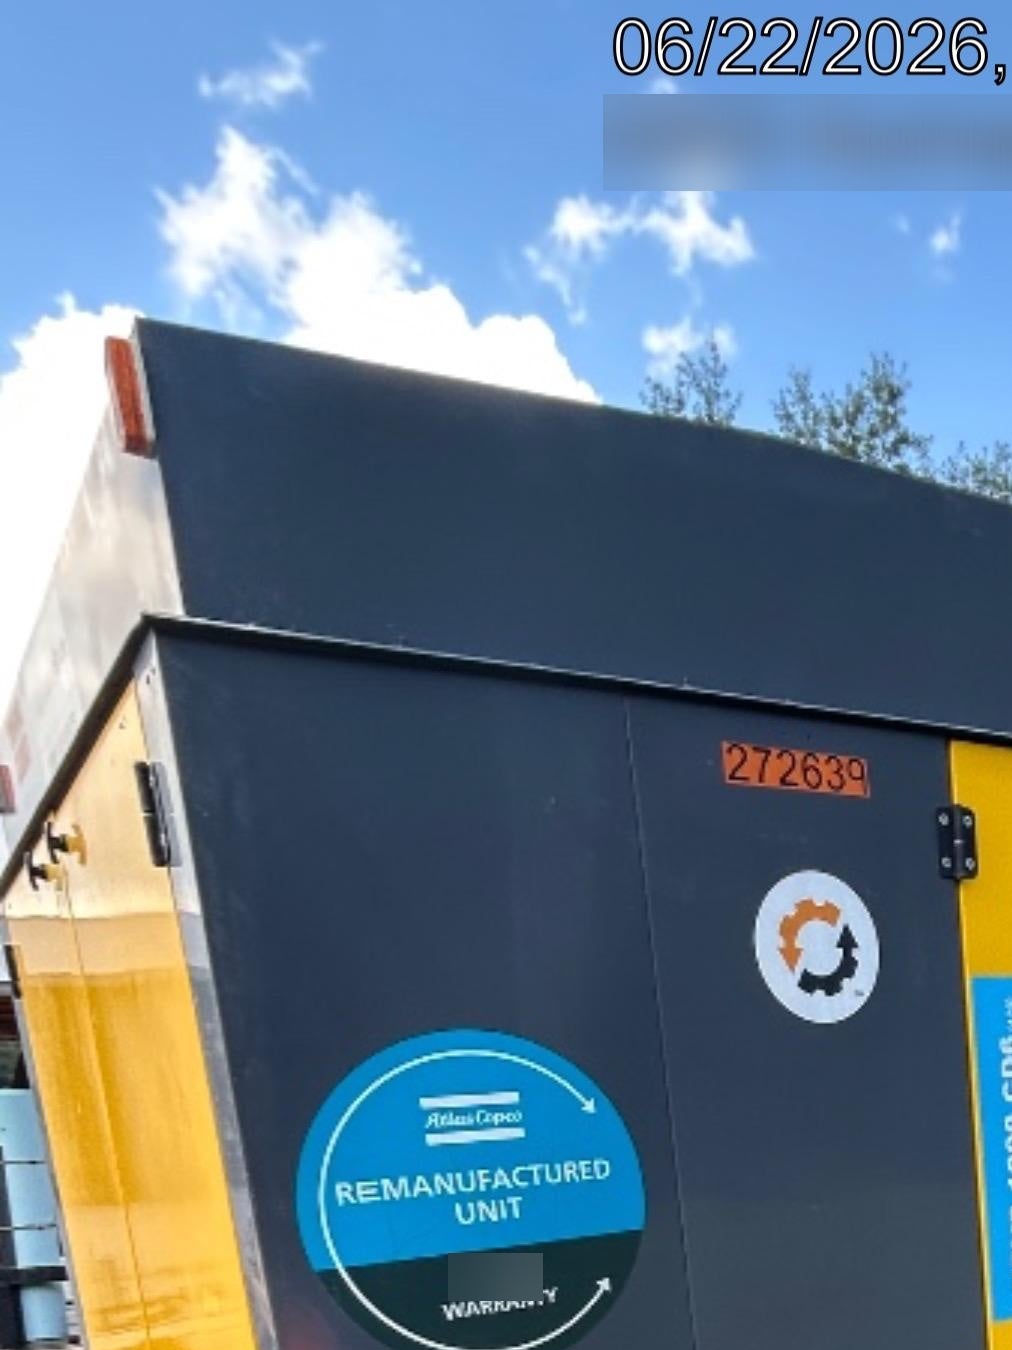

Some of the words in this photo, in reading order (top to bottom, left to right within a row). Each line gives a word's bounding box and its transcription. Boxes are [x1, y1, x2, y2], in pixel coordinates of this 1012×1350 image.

[725, 743, 869, 796] 272639
[425, 1112, 475, 1129] Atlas
[476, 1109, 523, 1127] Copco
[334, 1157, 611, 1207] REMANUFACTURED
[454, 1195, 523, 1225] UNIT
